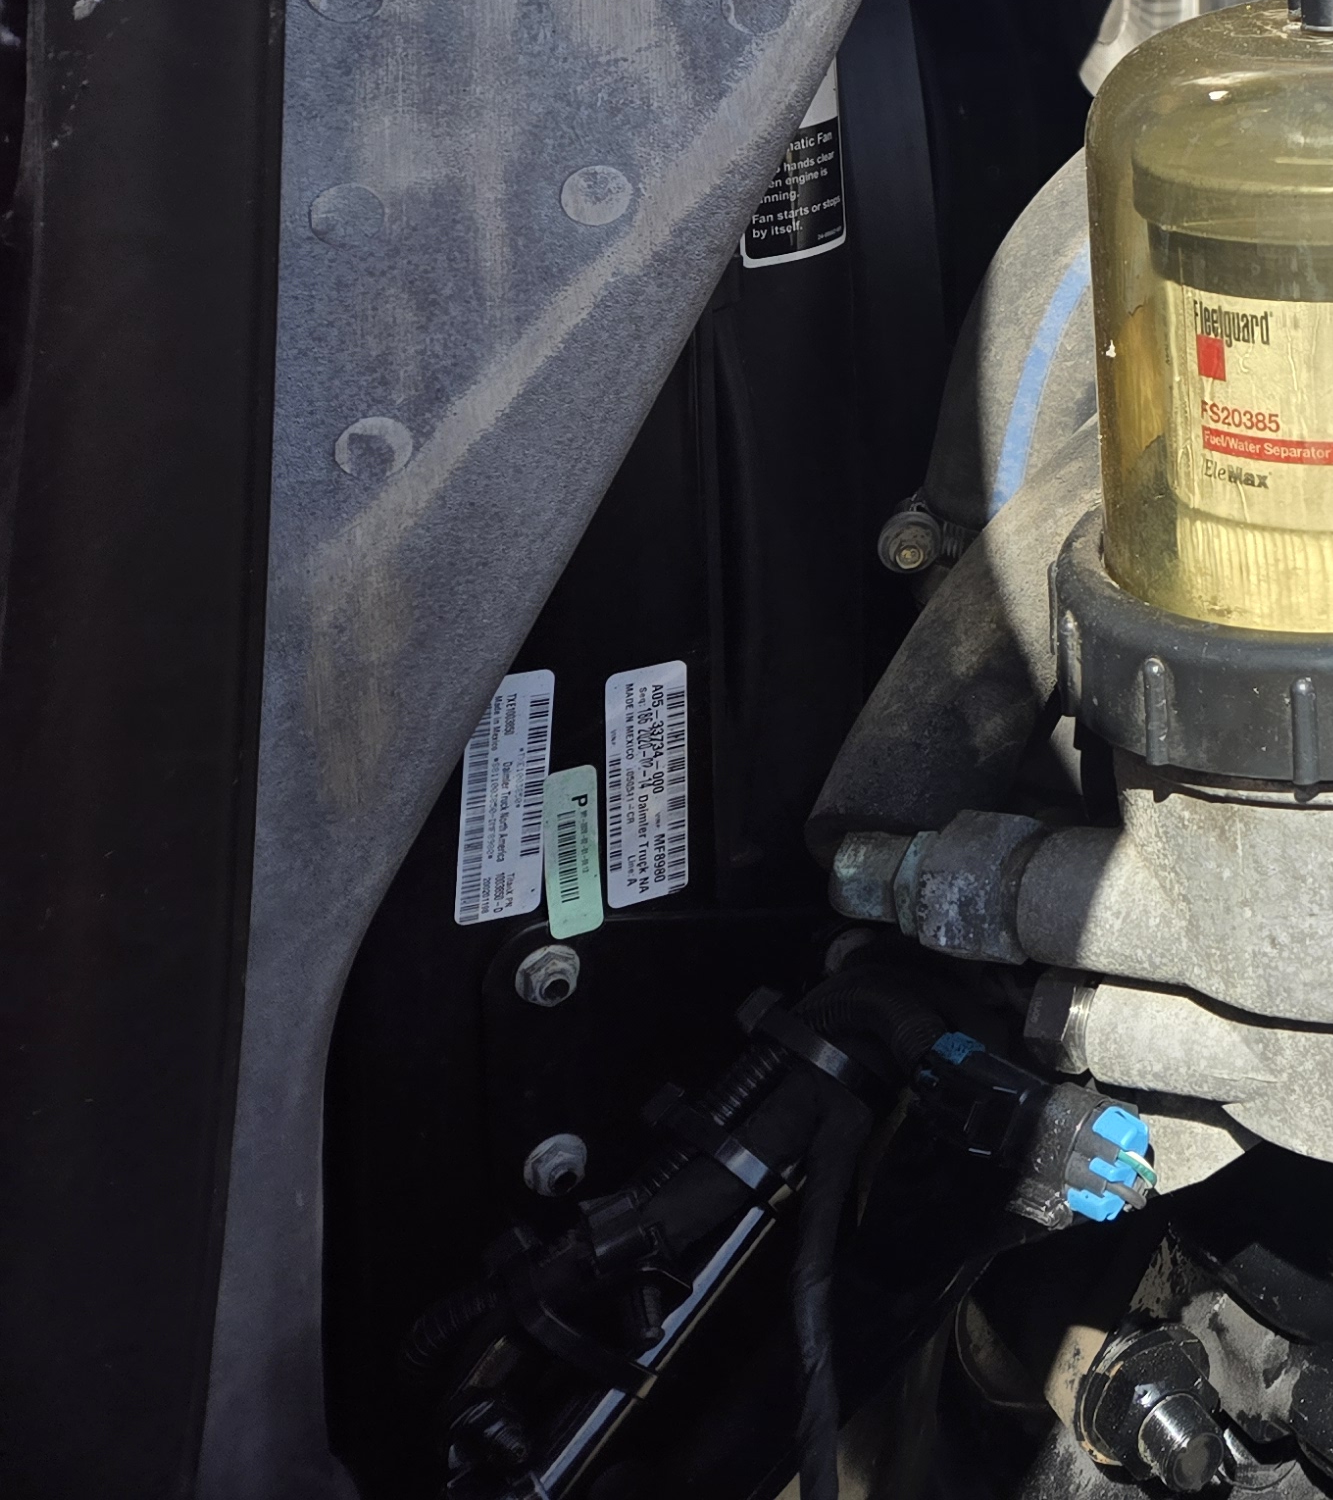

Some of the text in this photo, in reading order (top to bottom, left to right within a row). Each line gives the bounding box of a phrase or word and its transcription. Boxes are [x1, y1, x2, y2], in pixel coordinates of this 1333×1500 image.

[817, 130, 833, 145] Fan
[783, 150, 835, 172] hands clear
[785, 167, 828, 187] engine is
[751, 195, 841, 225] Fan starts or stops
[752, 229, 767, 240] by
[771, 220, 803, 236] itself.
[1201, 400, 1281, 433] FS20385
[1203, 430, 1332, 462] Fuel/Water Separator
[493, 695, 503, 716] Made
[624, 683, 635, 710] MADE
[625, 713, 635, 724] IN
[490, 726, 500, 752] Mexico
[625, 726, 635, 760] MEXICO
[650, 684, 666, 883] A05-33734-000 MF8980
[499, 791, 511, 811] Truck
[571, 793, 588, 808] P
[498, 812, 509, 832] North
[637, 794, 649, 839] Daimler
[495, 833, 508, 863] America
[636, 841, 649, 874] Truck
[626, 878, 637, 887] A
[638, 877, 649, 894] NA
